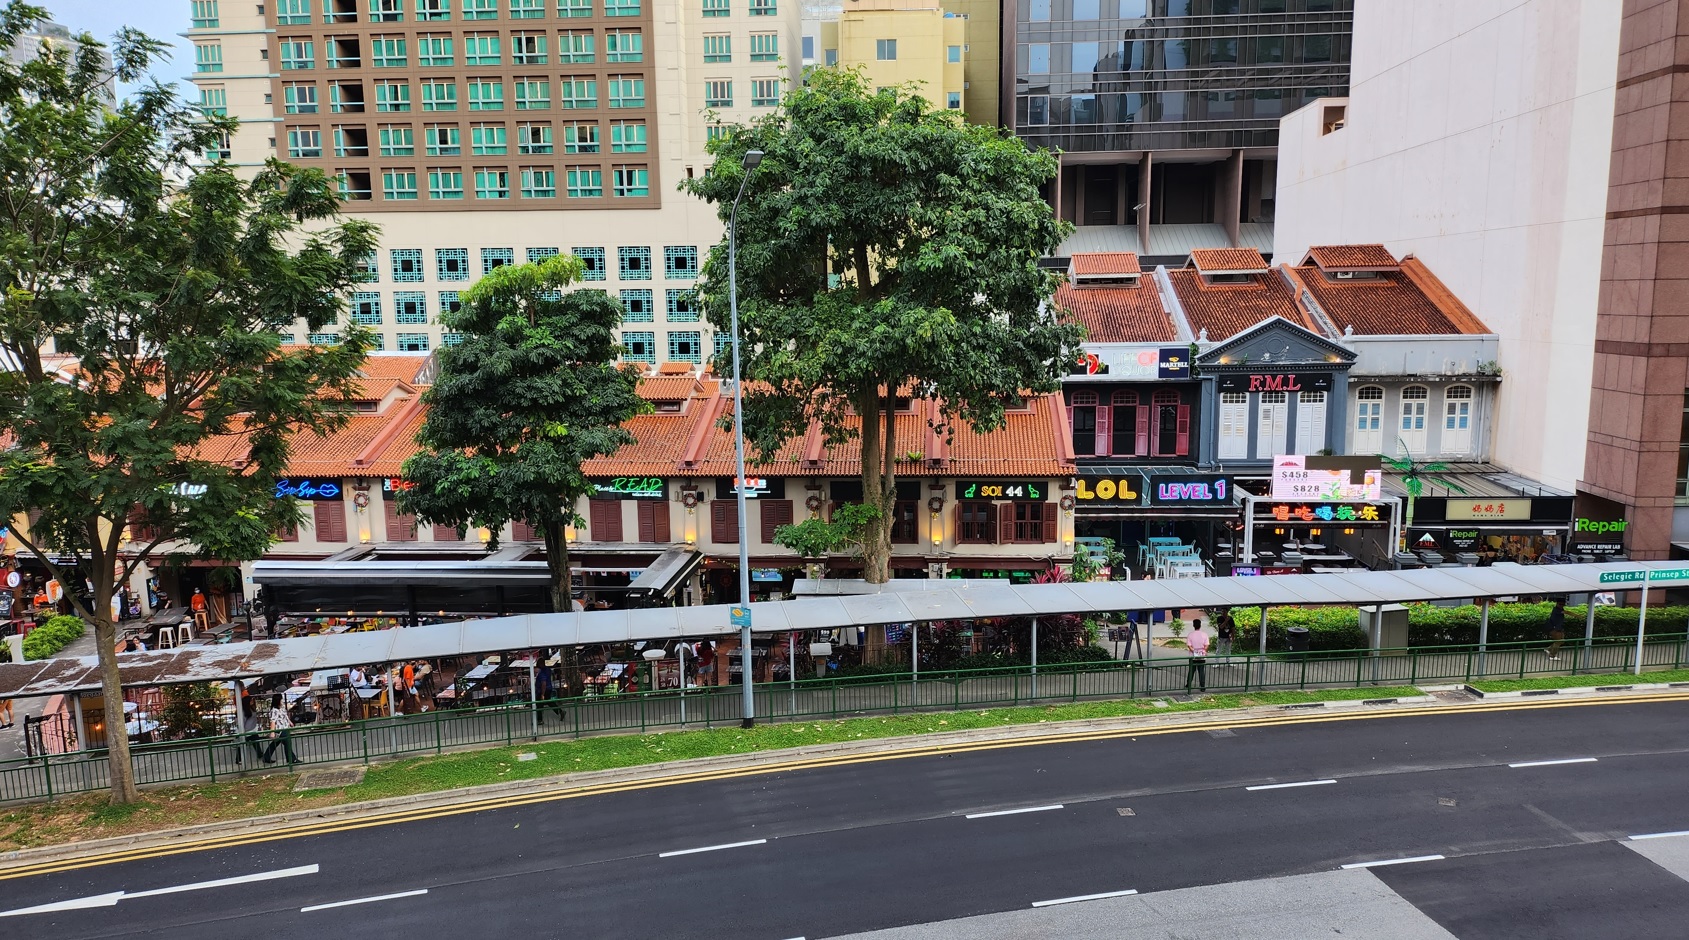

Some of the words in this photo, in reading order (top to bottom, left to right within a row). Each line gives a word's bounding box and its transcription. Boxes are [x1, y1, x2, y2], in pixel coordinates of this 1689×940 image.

[1281, 471, 1308, 479] $458
[981, 486, 1002, 496] SOI
[1005, 485, 1023, 497] 44
[1077, 479, 1137, 500] LOL
[1158, 482, 1212, 500] LEVEL
[1214, 479, 1226, 500] 1
[1293, 485, 1320, 493] $828
[1574, 518, 1629, 534] iRepair
[1450, 529, 1478, 539] iRepair
[1603, 573, 1632, 582] Selegie
[1635, 571, 1645, 579] Rd
[1650, 570, 1679, 580] Prinsep
